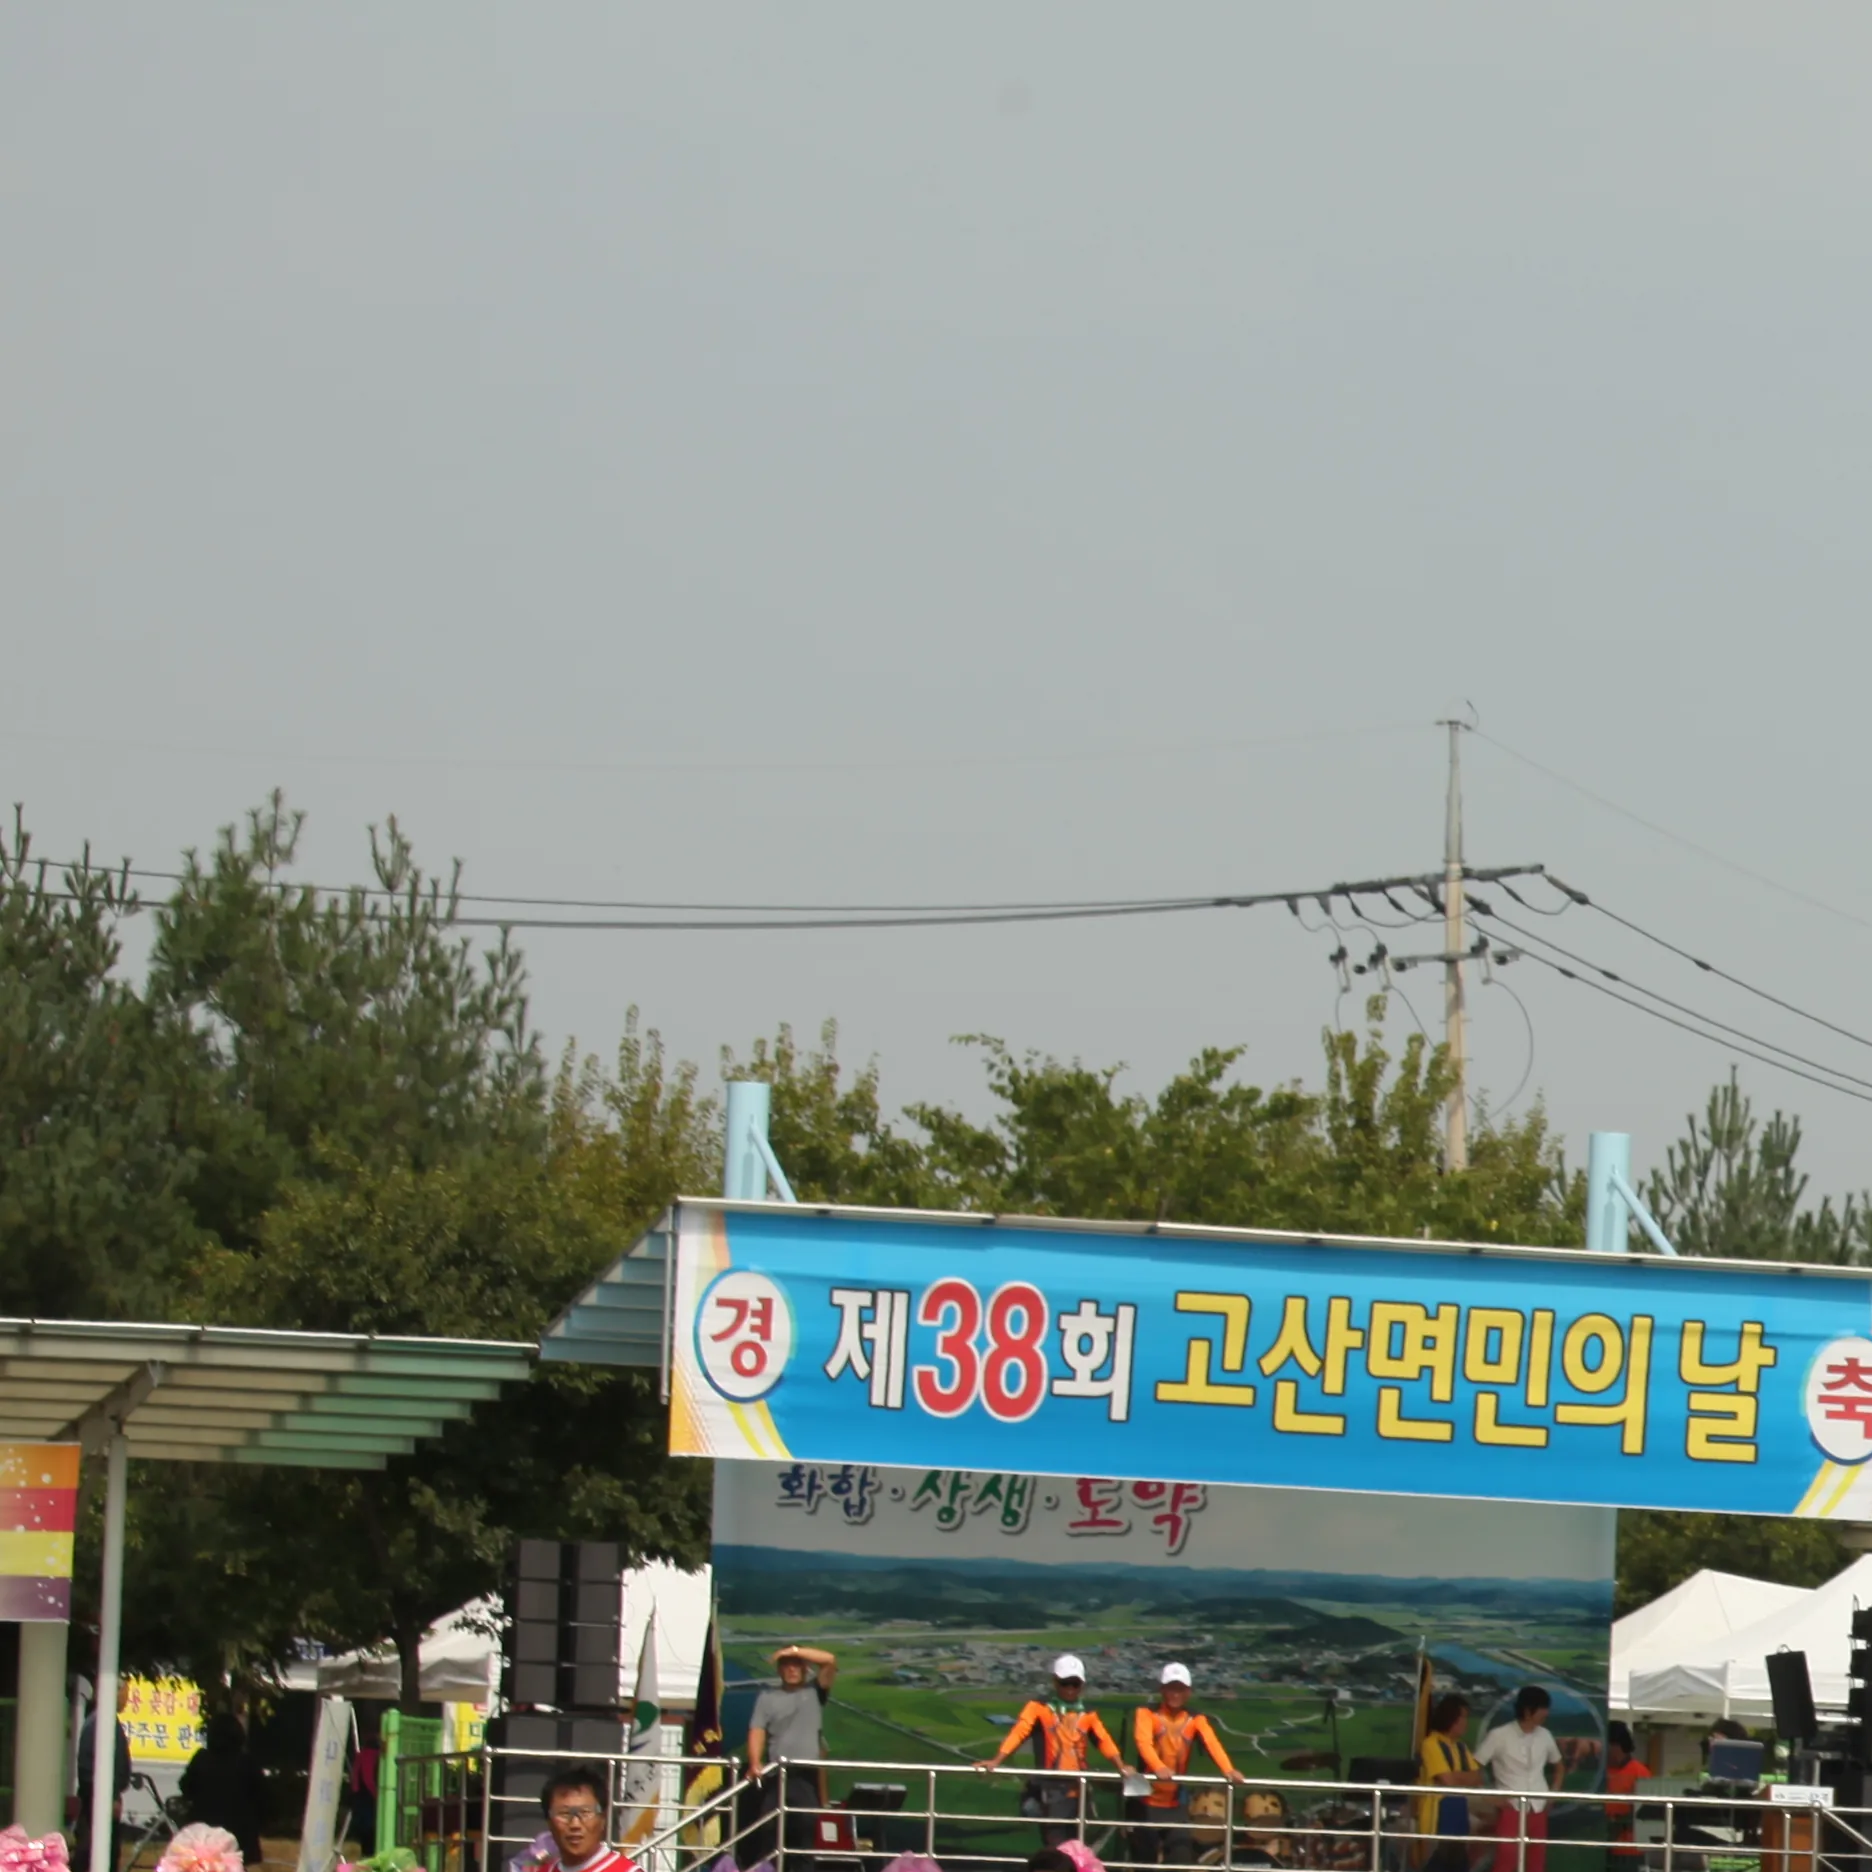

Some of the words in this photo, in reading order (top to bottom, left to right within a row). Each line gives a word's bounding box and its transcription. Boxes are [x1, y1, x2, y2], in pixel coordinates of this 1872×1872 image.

[709, 1296, 774, 1379] 경
[823, 1275, 1138, 1425] 제38회
[1154, 1289, 1656, 1457] 고산면민의
[1678, 1310, 1778, 1464] 날
